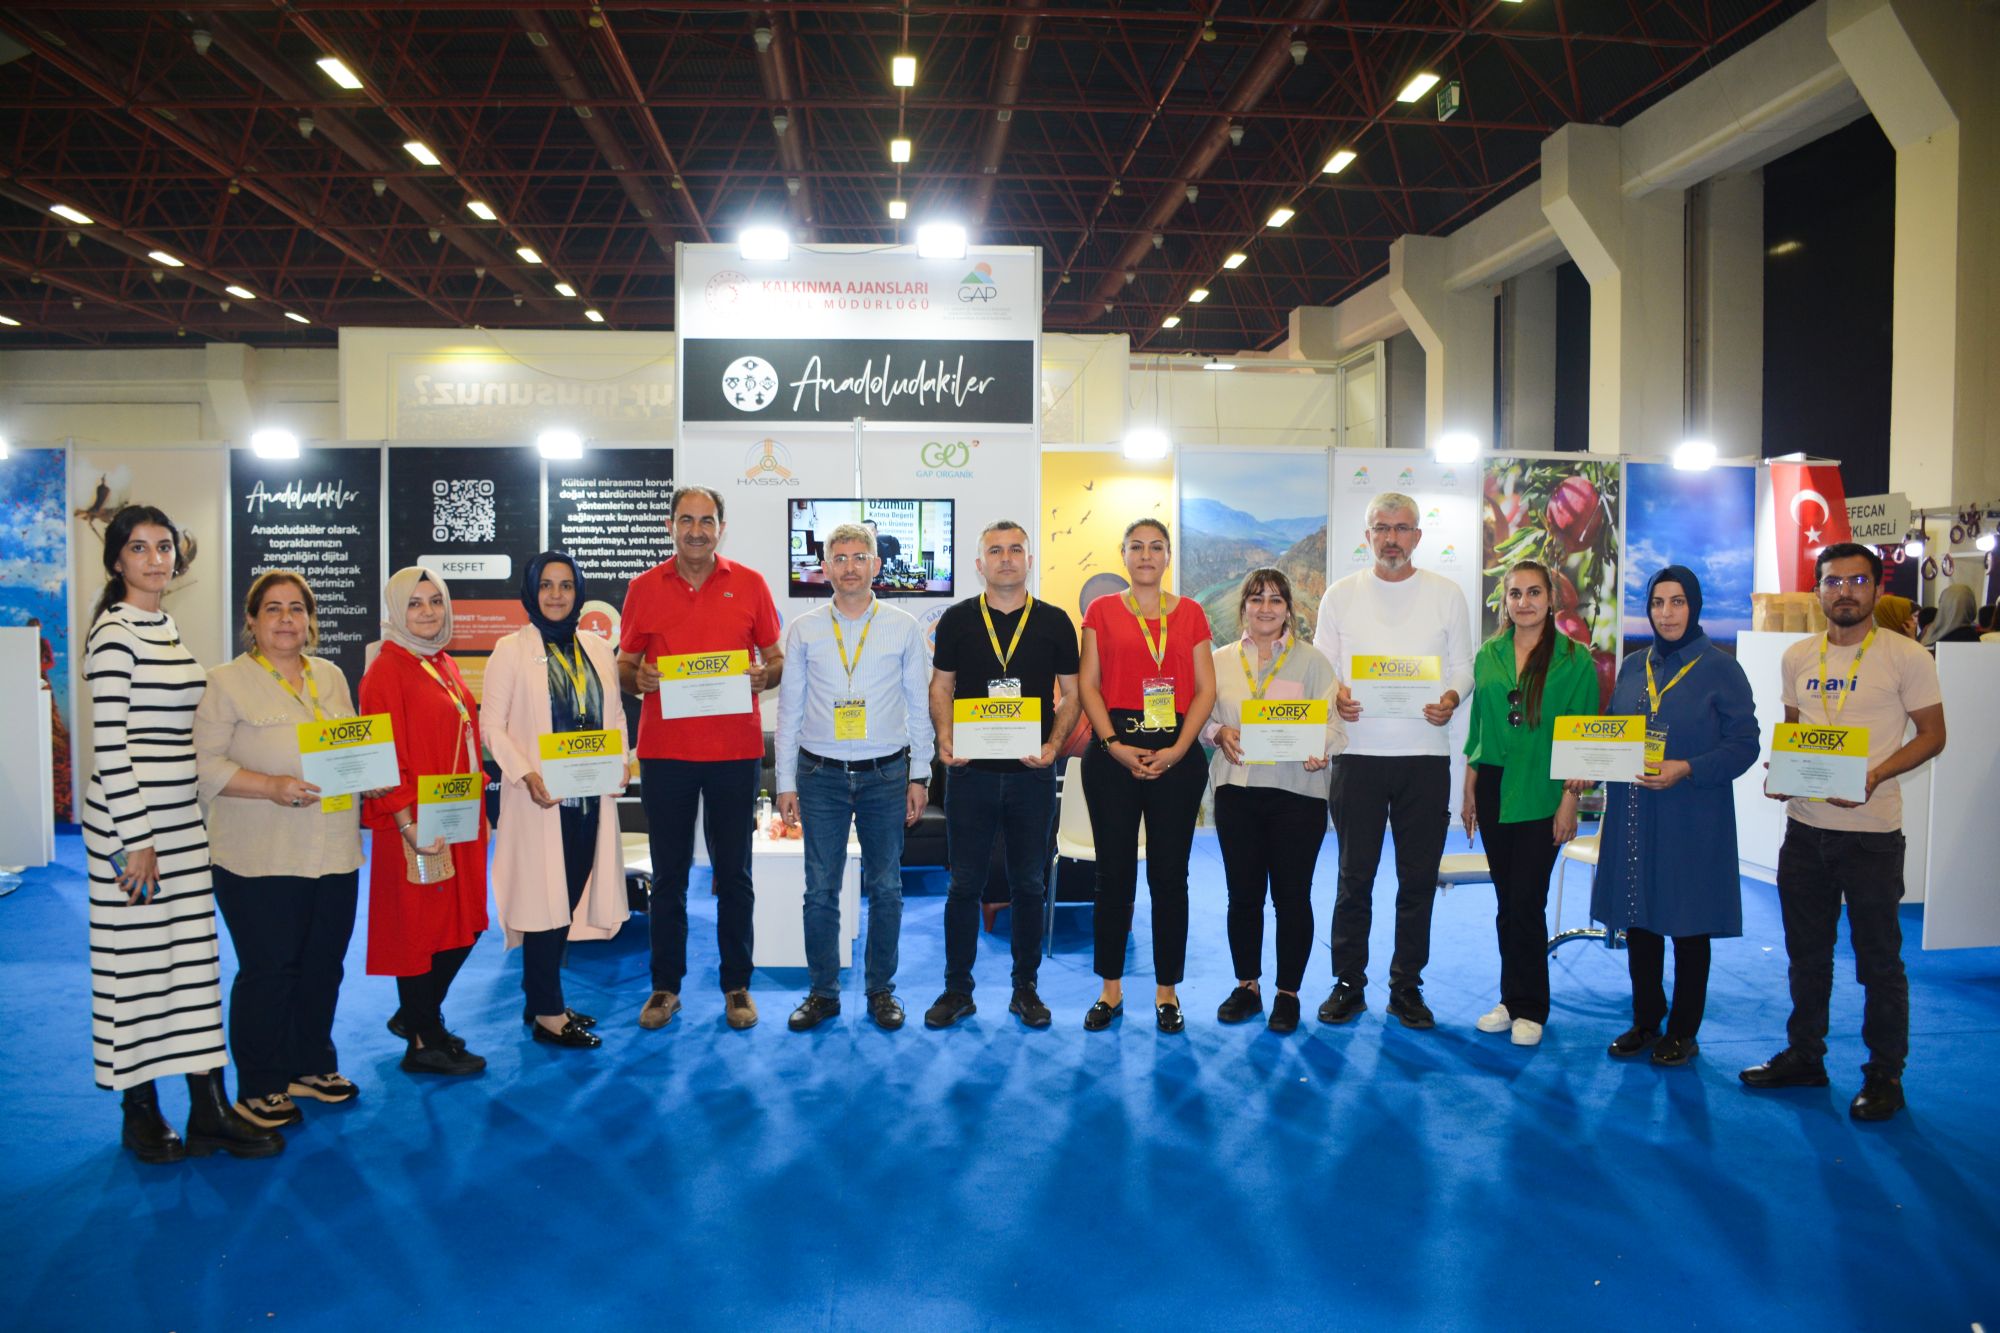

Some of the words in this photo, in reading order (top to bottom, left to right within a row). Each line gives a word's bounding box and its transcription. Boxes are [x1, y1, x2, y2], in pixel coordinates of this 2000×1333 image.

[762, 281, 842, 294] KALKINMA
[846, 280, 929, 295] AJANSLARI
[958, 286, 997, 303] GAP
[824, 297, 929, 310] MÜDÜRLÜĞÜ
[789, 354, 996, 412] Anadoludakiler
[916, 470, 933, 478] GAP
[561, 478, 596, 487] Kültürel
[598, 478, 643, 487] mirasımızı
[645, 478, 673, 487] korurk
[737, 478, 800, 486] HASSAS
[245, 479, 360, 513] Anadoludakiler
[559, 489, 585, 500] doğal
[599, 489, 658, 499] sürdürülebilir
[576, 501, 634, 511] yöntemlerine
[636, 501, 648, 510] de
[567, 513, 616, 523] sağlayarak
[251, 524, 326, 535] Anadoludakiler
[327, 525, 361, 535] olarak,
[561, 525, 605, 534] korumayı,
[607, 525, 629, 534] yerel
[1852, 519, 1897, 538] KLARELİ
[269, 538, 342, 549] topraklarımızın
[562, 536, 626, 546] canlandırmayı,
[628, 537, 648, 546] yeni
[263, 552, 319, 563] zenginliğini
[321, 552, 349, 563] dijital
[616, 549, 656, 558] sunmayı,
[442, 562, 485, 573] KEŞFET
[576, 559, 599, 569] eyde
[601, 559, 644, 568] ekonomik
[646, 560, 656, 568] ve
[307, 565, 361, 576] paylaşarak
[314, 592, 347, 602] mesini,
[592, 620, 599, 630] 1
[319, 632, 362, 643] siyellerin
